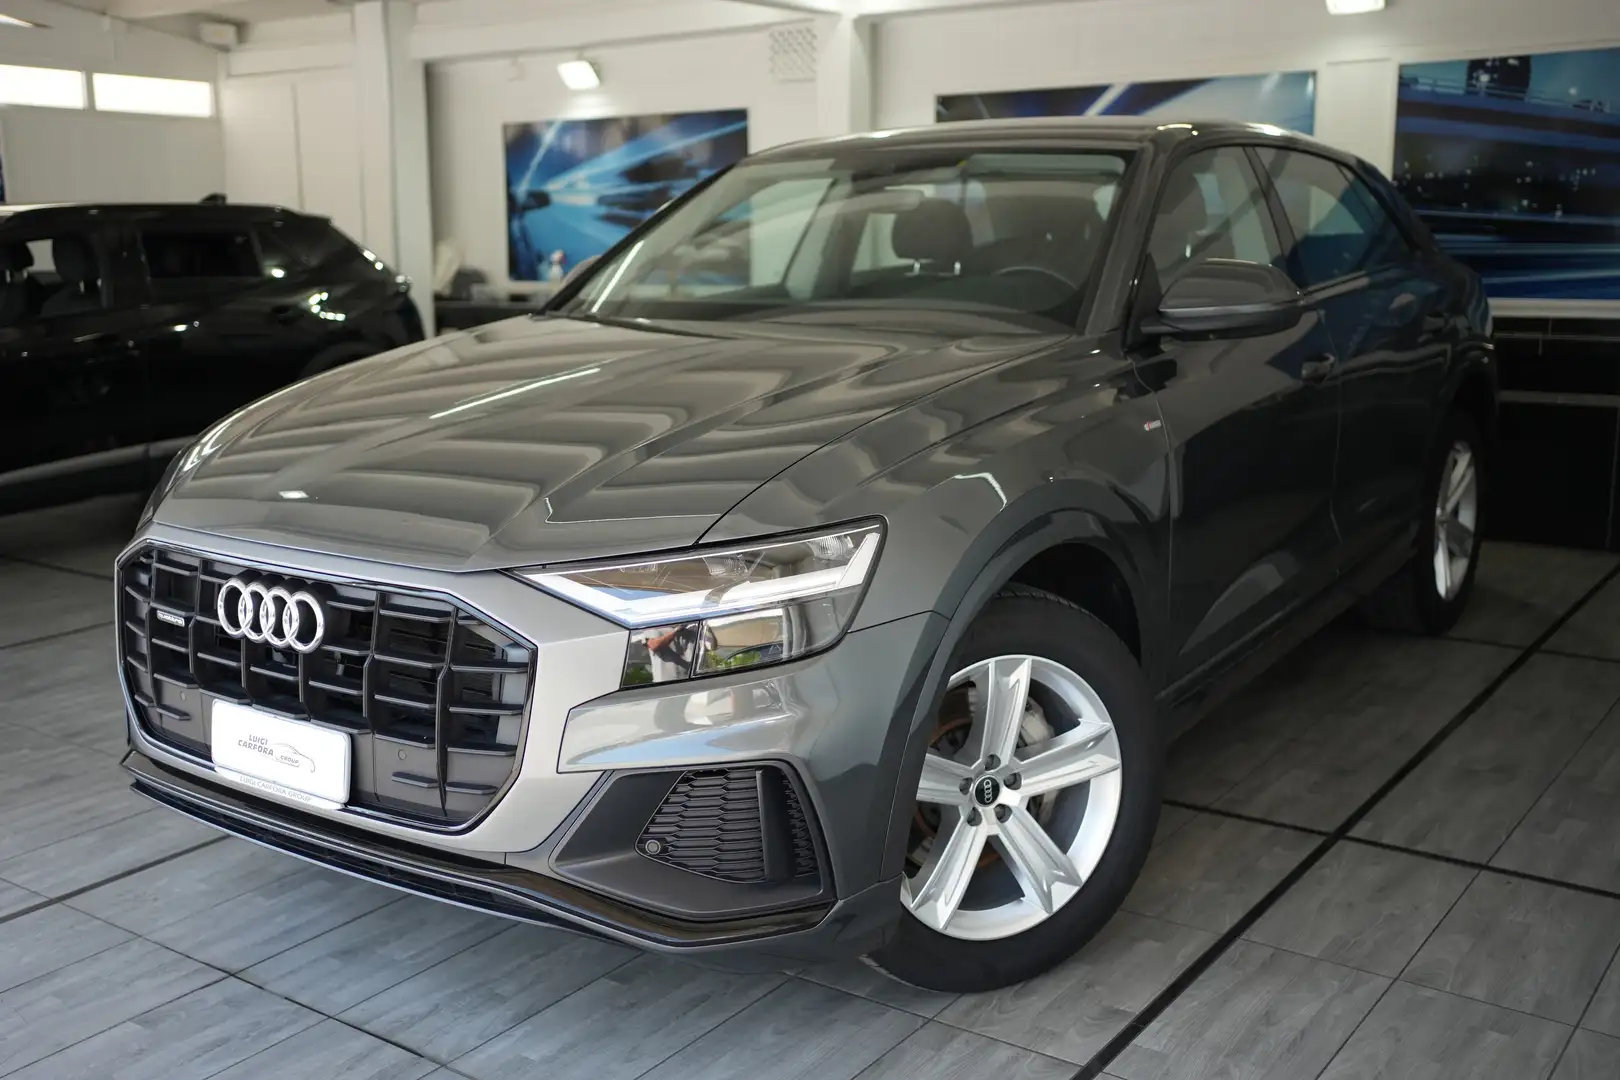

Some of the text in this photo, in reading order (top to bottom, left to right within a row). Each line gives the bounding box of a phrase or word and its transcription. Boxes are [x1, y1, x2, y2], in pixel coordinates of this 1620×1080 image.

[248, 734, 268, 746] LUIGI
[237, 739, 274, 757] CARFORA
[280, 754, 300, 764] GROUP
[239, 775, 312, 803] LUIGI CARFORA GROUP
